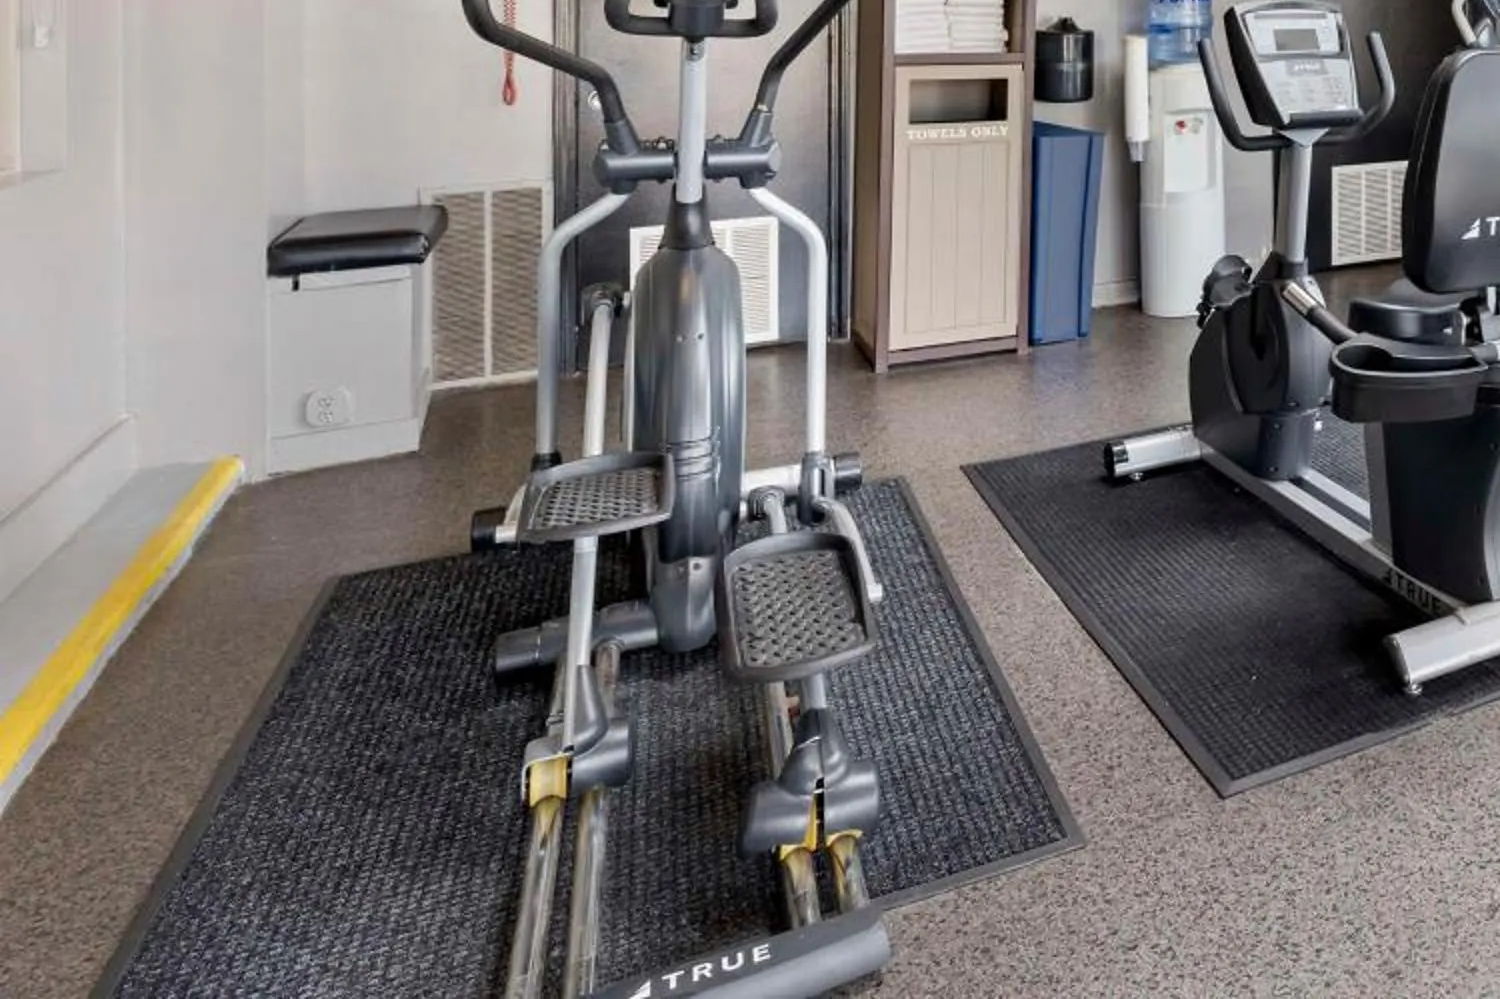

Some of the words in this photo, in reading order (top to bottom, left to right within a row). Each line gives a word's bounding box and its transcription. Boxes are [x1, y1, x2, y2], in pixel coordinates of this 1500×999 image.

[905, 128, 967, 140] TOWELS
[970, 124, 1009, 138] ONLY
[661, 943, 772, 990] TRUE
